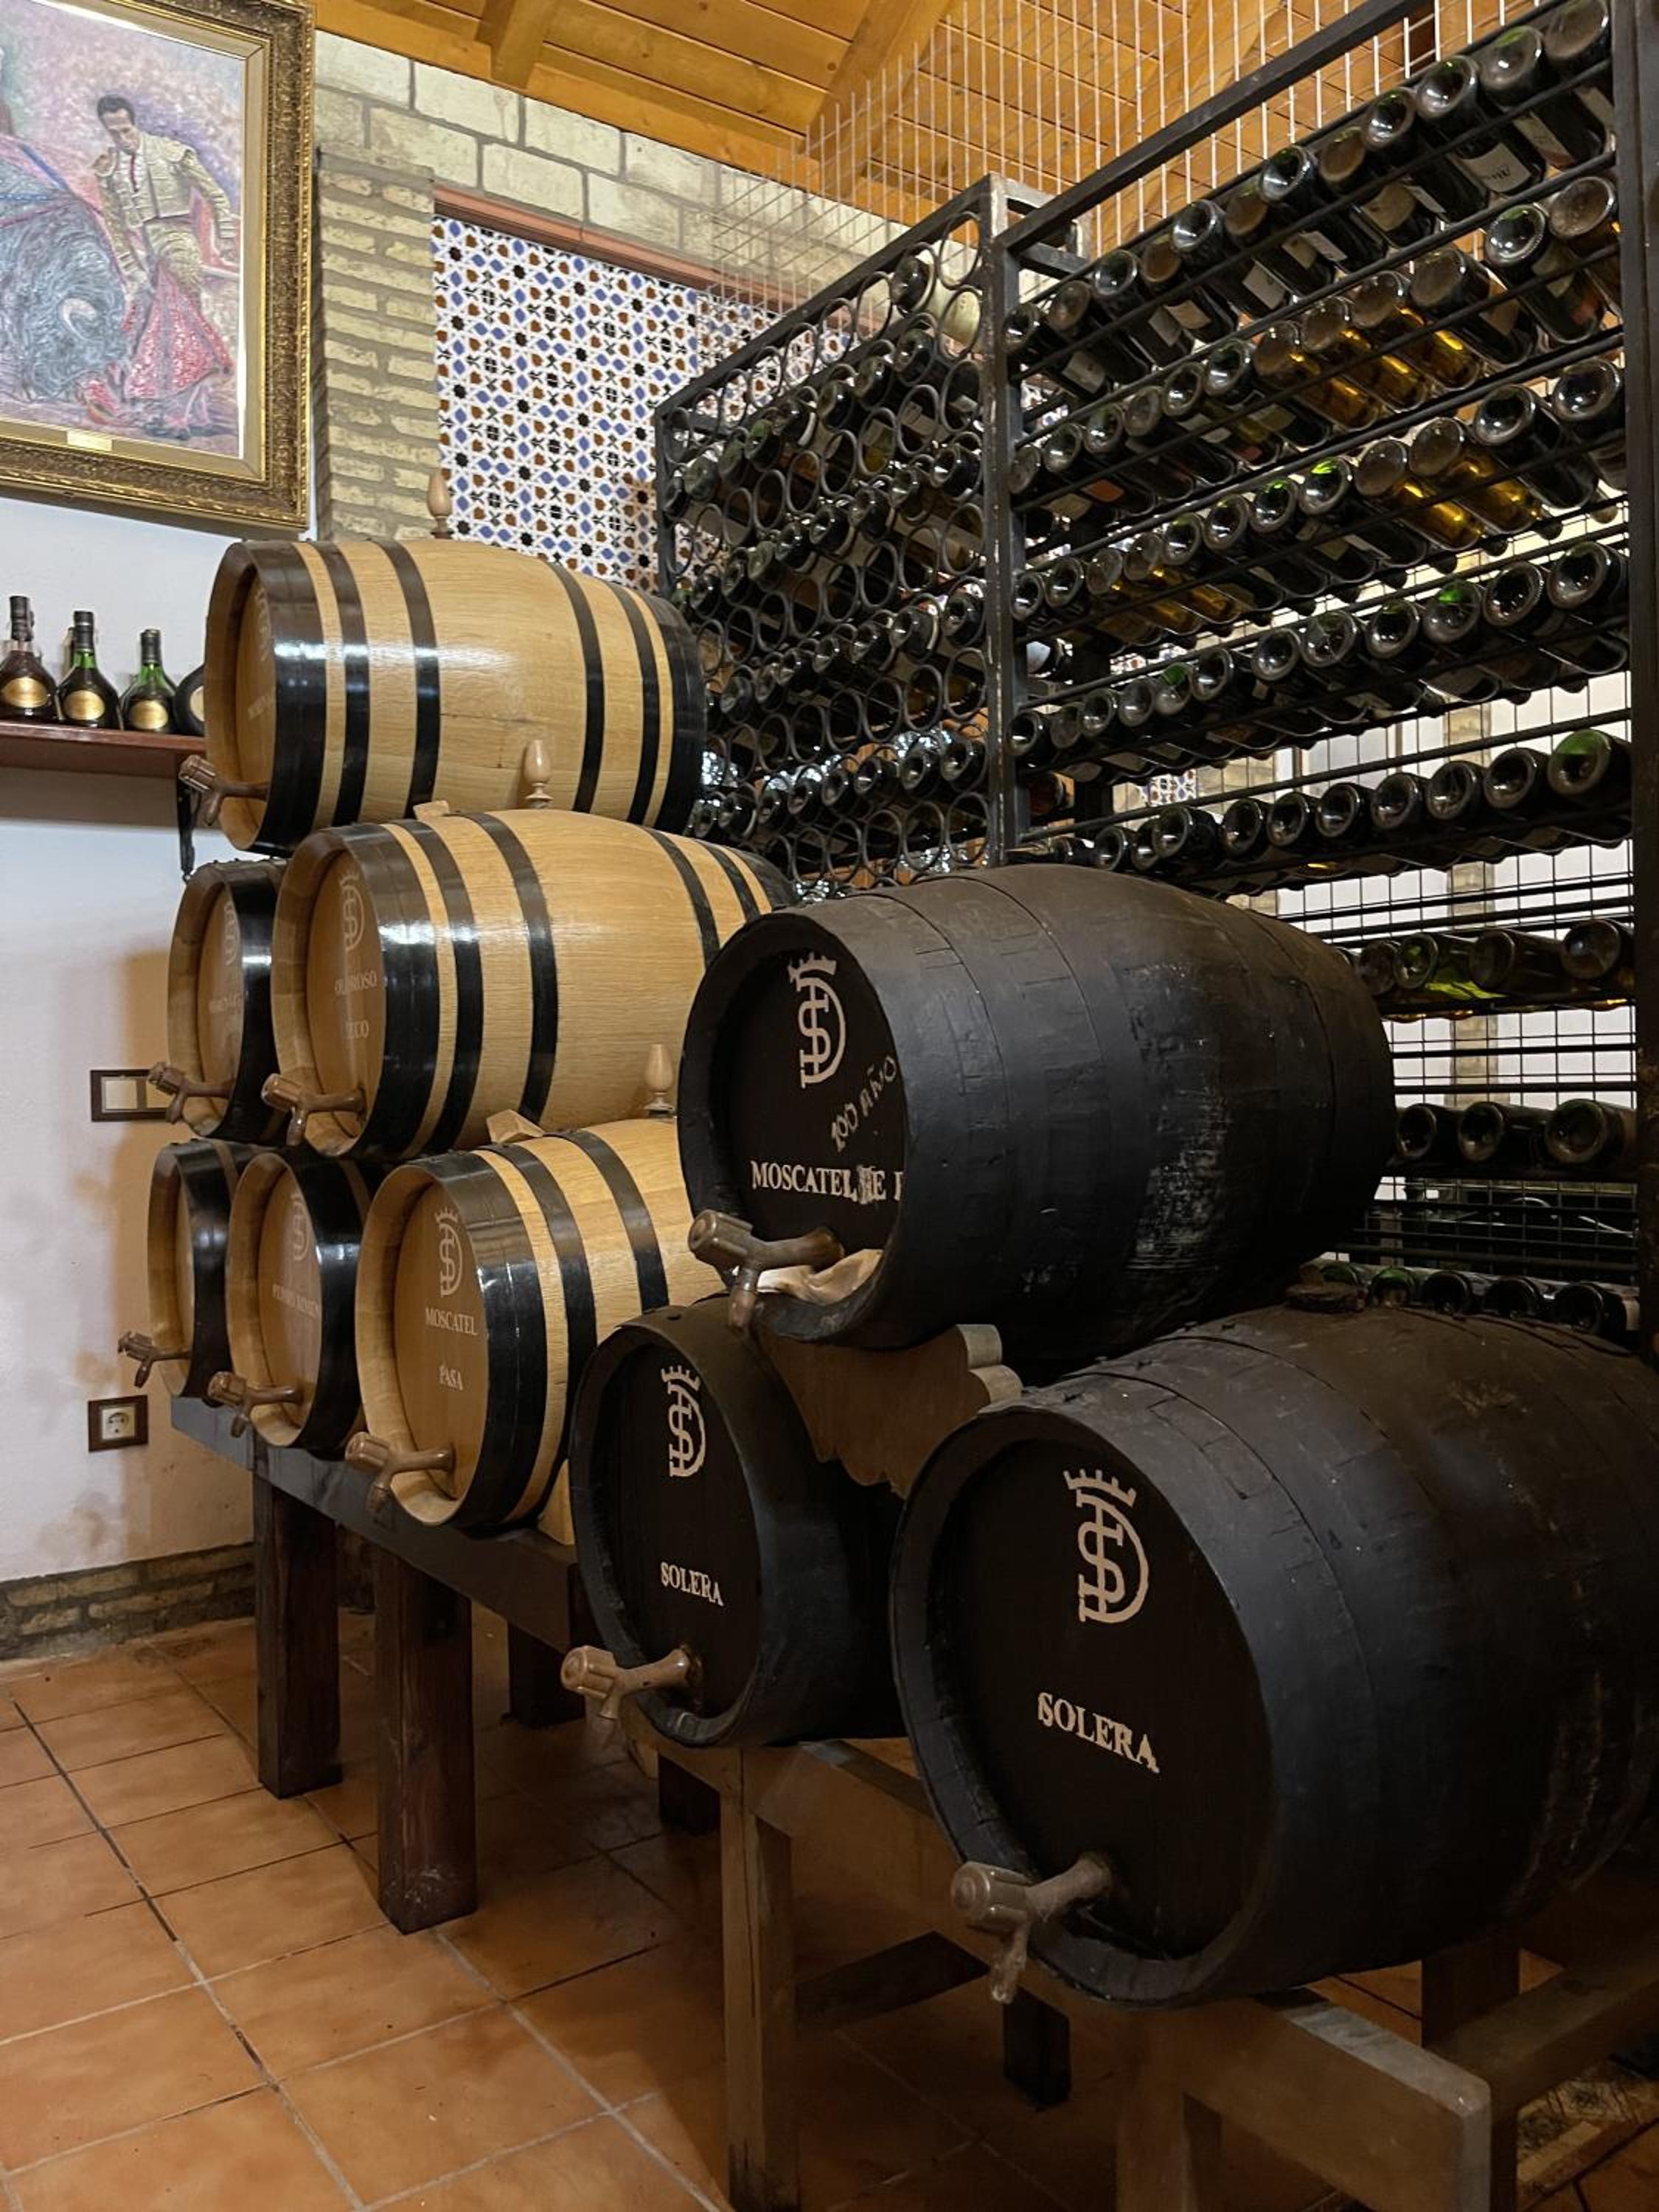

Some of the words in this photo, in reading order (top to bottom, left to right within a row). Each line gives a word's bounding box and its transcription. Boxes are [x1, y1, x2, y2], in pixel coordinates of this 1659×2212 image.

[750, 1160, 858, 1203] MOSCATEL
[425, 1307, 479, 1335] MOSCATEL
[660, 1561, 724, 1607] SOLERA
[1037, 1692, 1160, 1773] SOLERA
